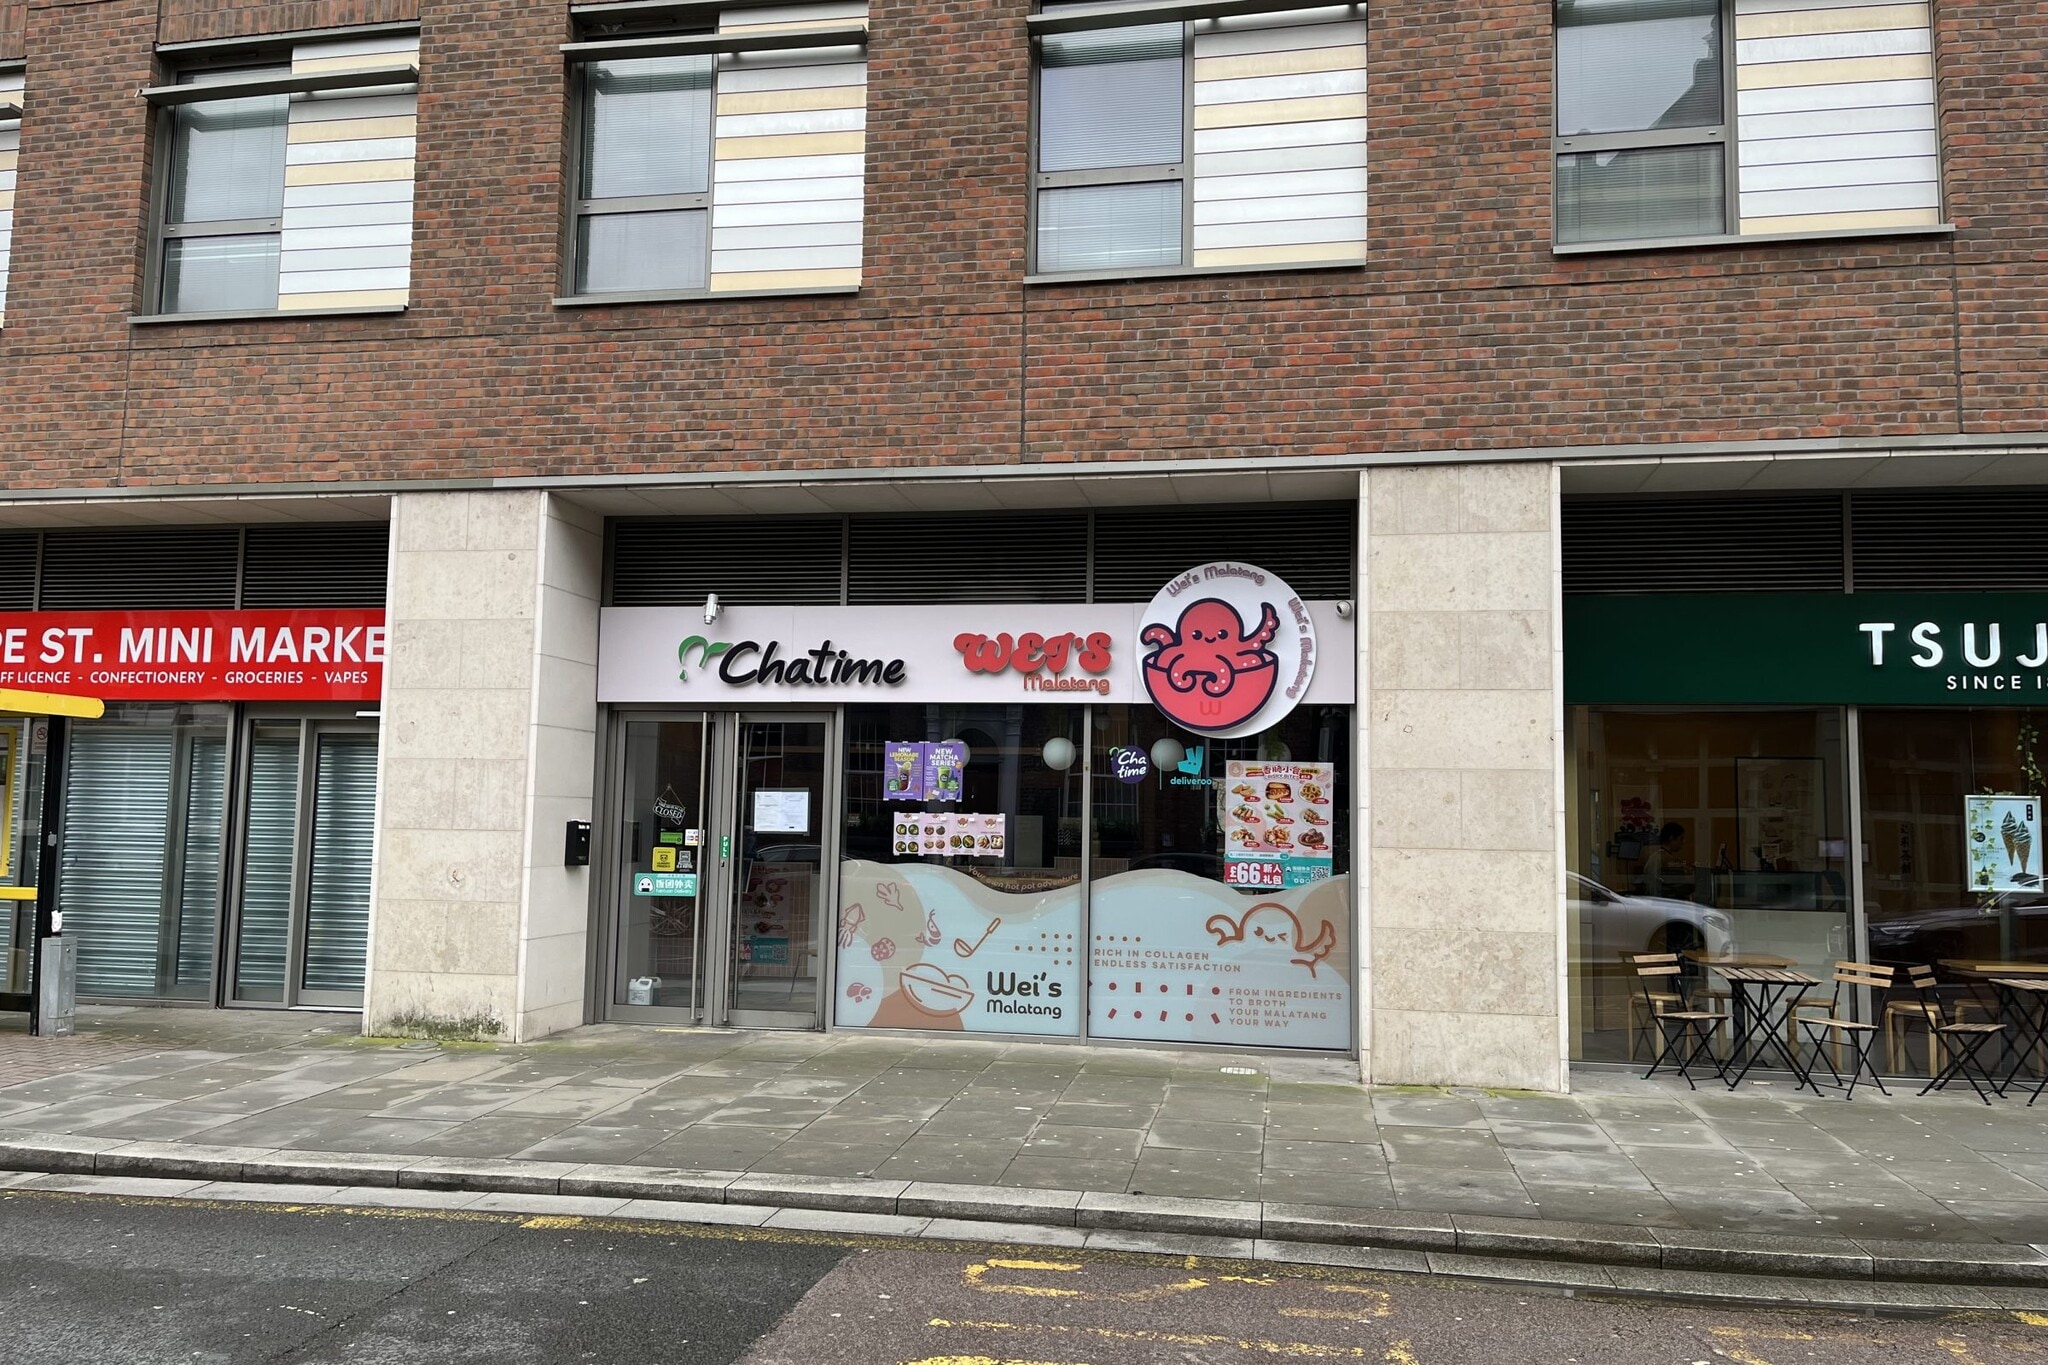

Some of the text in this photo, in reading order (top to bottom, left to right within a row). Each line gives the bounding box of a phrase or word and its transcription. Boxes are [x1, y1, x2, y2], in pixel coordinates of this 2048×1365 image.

[1166, 563, 1266, 597] Wei's Malatang
[0, 626, 386, 664] E ST. MINI MARKE
[1285, 597, 1313, 699] Wei's Malatang
[1858, 621, 2048, 668] TSUJ
[718, 639, 908, 685] Chatime
[17, 671, 71, 684] LICENCE
[90, 670, 205, 684] CONFECTIONERY
[225, 671, 304, 684] GROCERIES
[324, 671, 368, 684] VAPES
[1023, 672, 1110, 696] Malatang
[1946, 675, 2048, 690] SINCE 1
[1117, 751, 1147, 765] Cha
[1117, 765, 1147, 779] time
[1170, 776, 1213, 785] deliveroo
[655, 805, 682, 819] CLOSED
[1263, 864, 1282, 873] 新人
[968, 864, 986, 880] Your
[986, 878, 1004, 888] own
[1021, 884, 1035, 892] pot
[1037, 873, 1079, 888] adventure
[1263, 875, 1282, 885] 礼包
[1145, 950, 1209, 960] COLLAGEN
[1094, 959, 1241, 972] ENDLESS SATISFACTION
[987, 971, 1062, 998] Wei's
[1229, 988, 1342, 1000] FROM INGREDIENTS
[986, 999, 1062, 1019] Malatang
[1248, 999, 1286, 1007] BROTH
[1229, 1008, 1327, 1019] YOUR MALATANG
[1229, 1018, 1289, 1027] YOUR WAY
